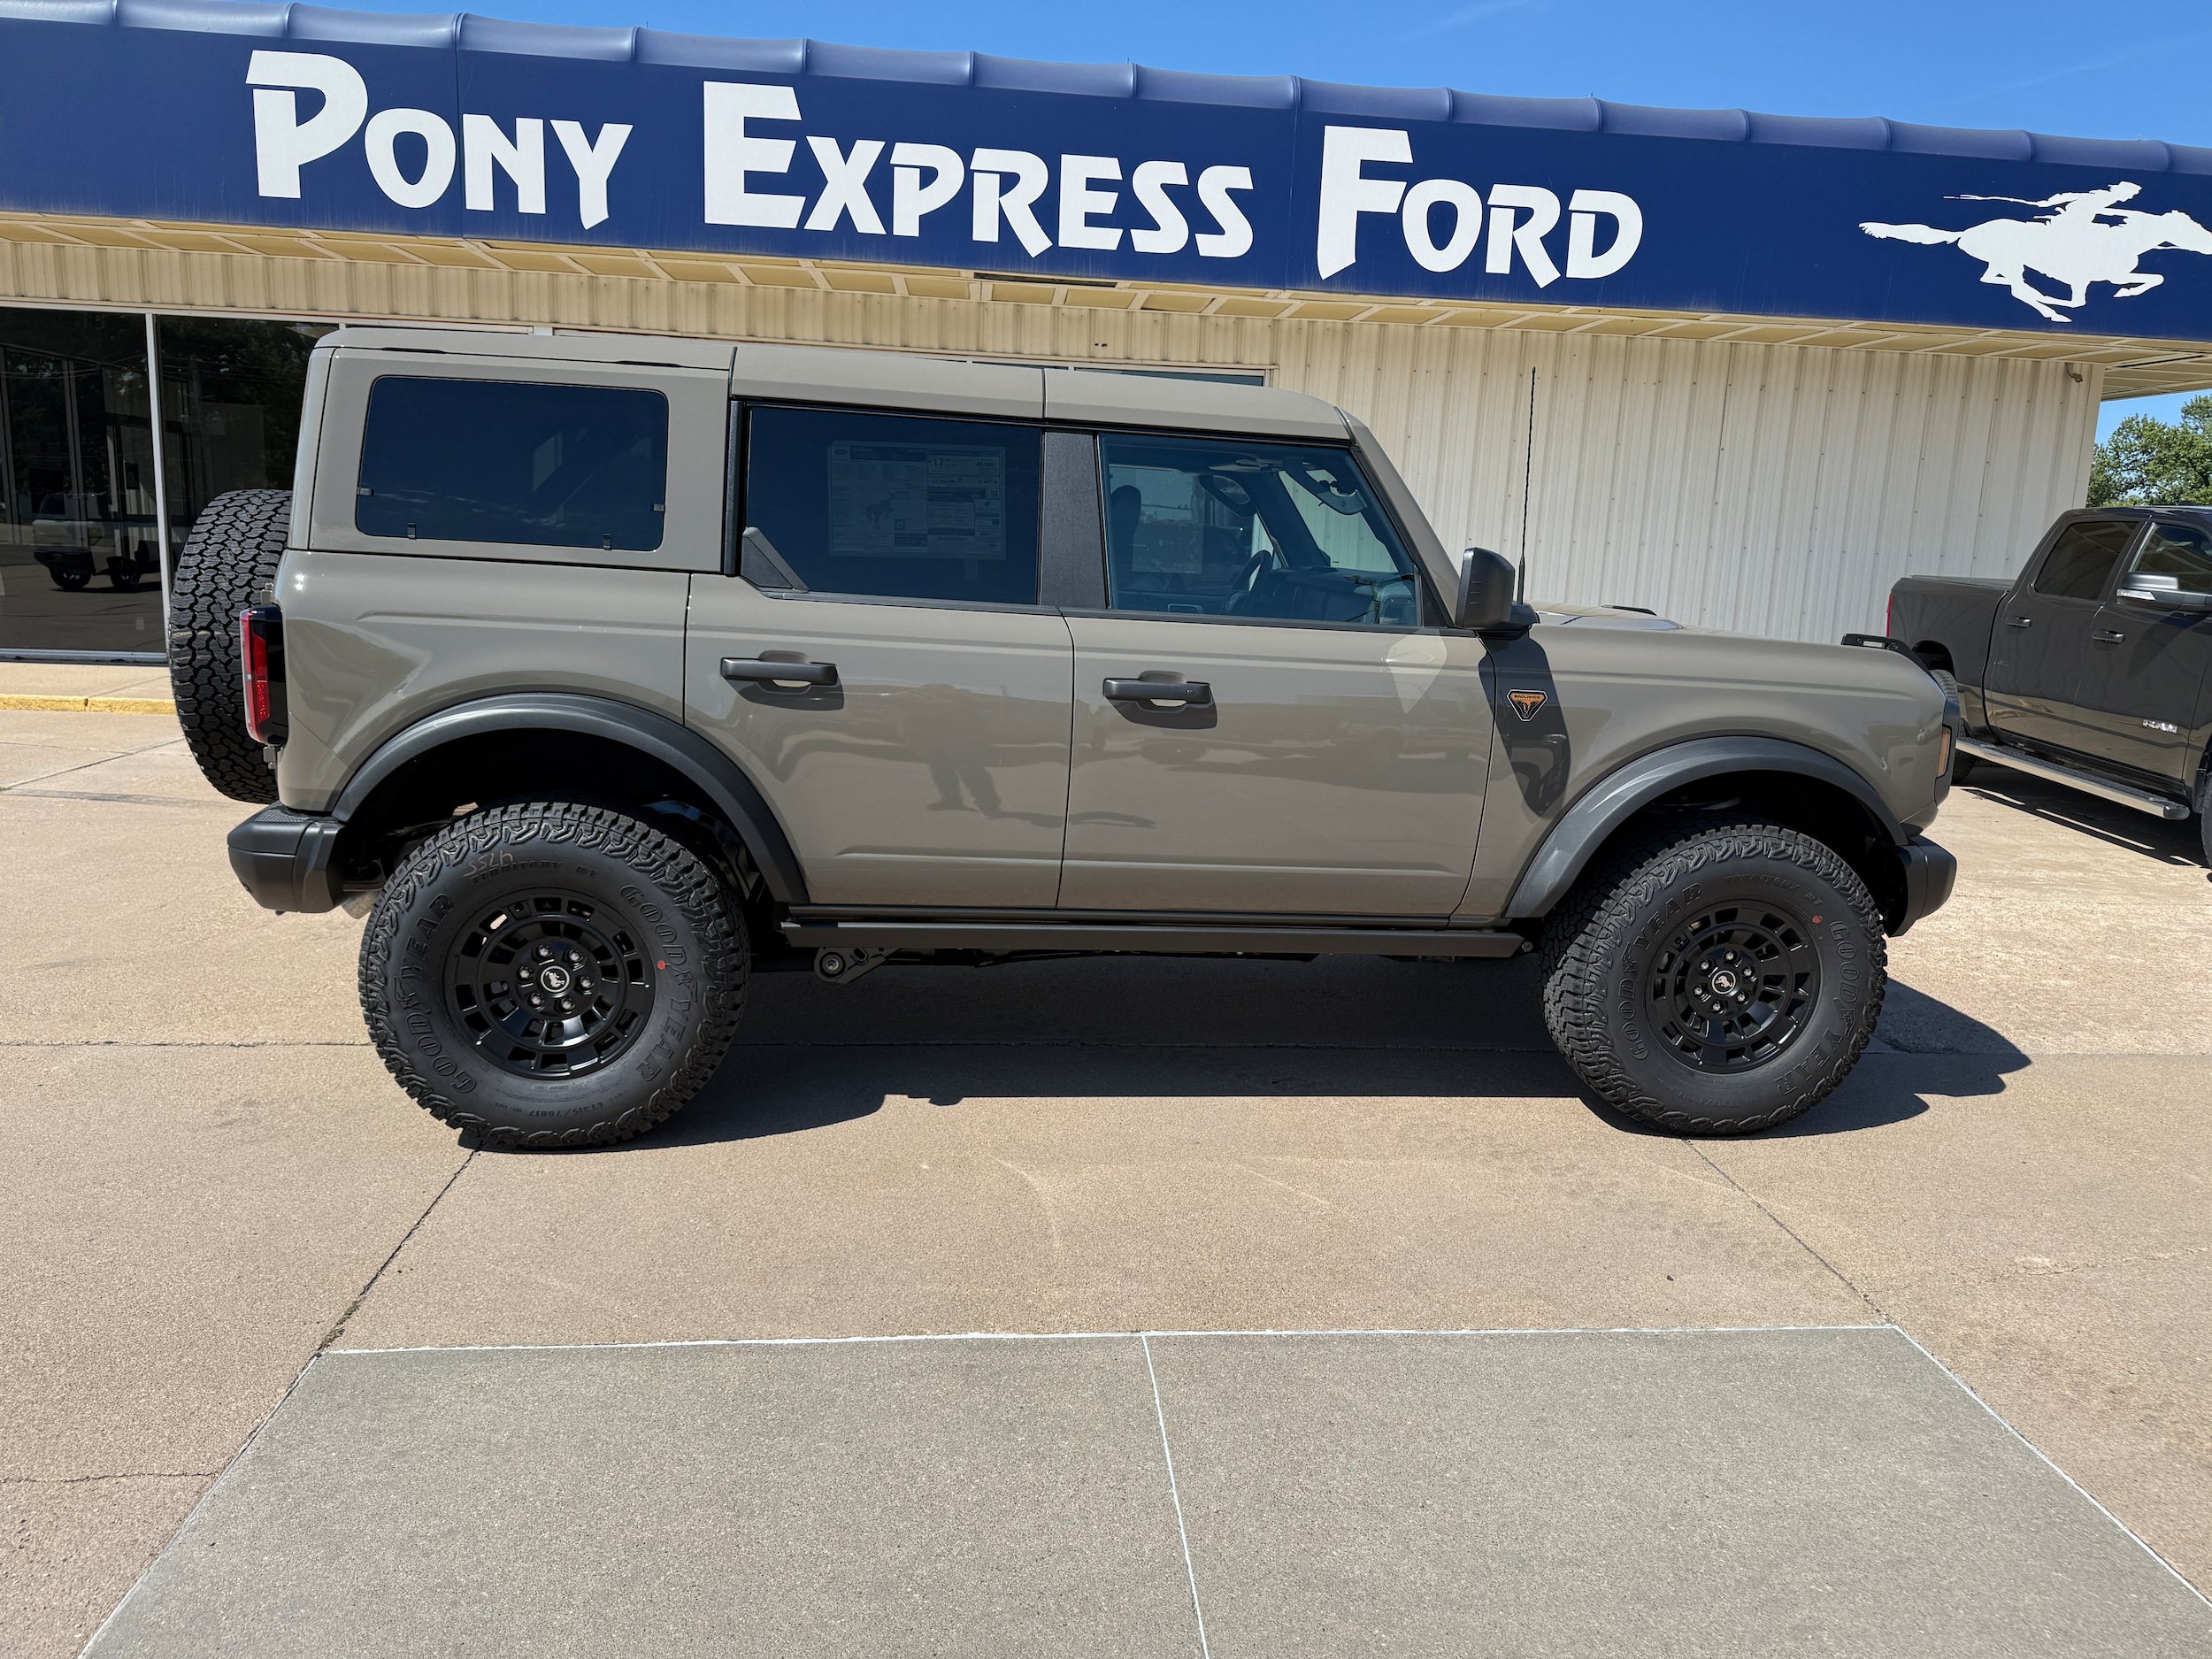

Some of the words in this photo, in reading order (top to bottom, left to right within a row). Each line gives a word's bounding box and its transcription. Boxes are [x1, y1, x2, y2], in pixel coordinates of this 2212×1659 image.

[245, 50, 634, 230] PONY
[703, 81, 1254, 258] EXPRESS
[1317, 125, 1643, 289] FORD
